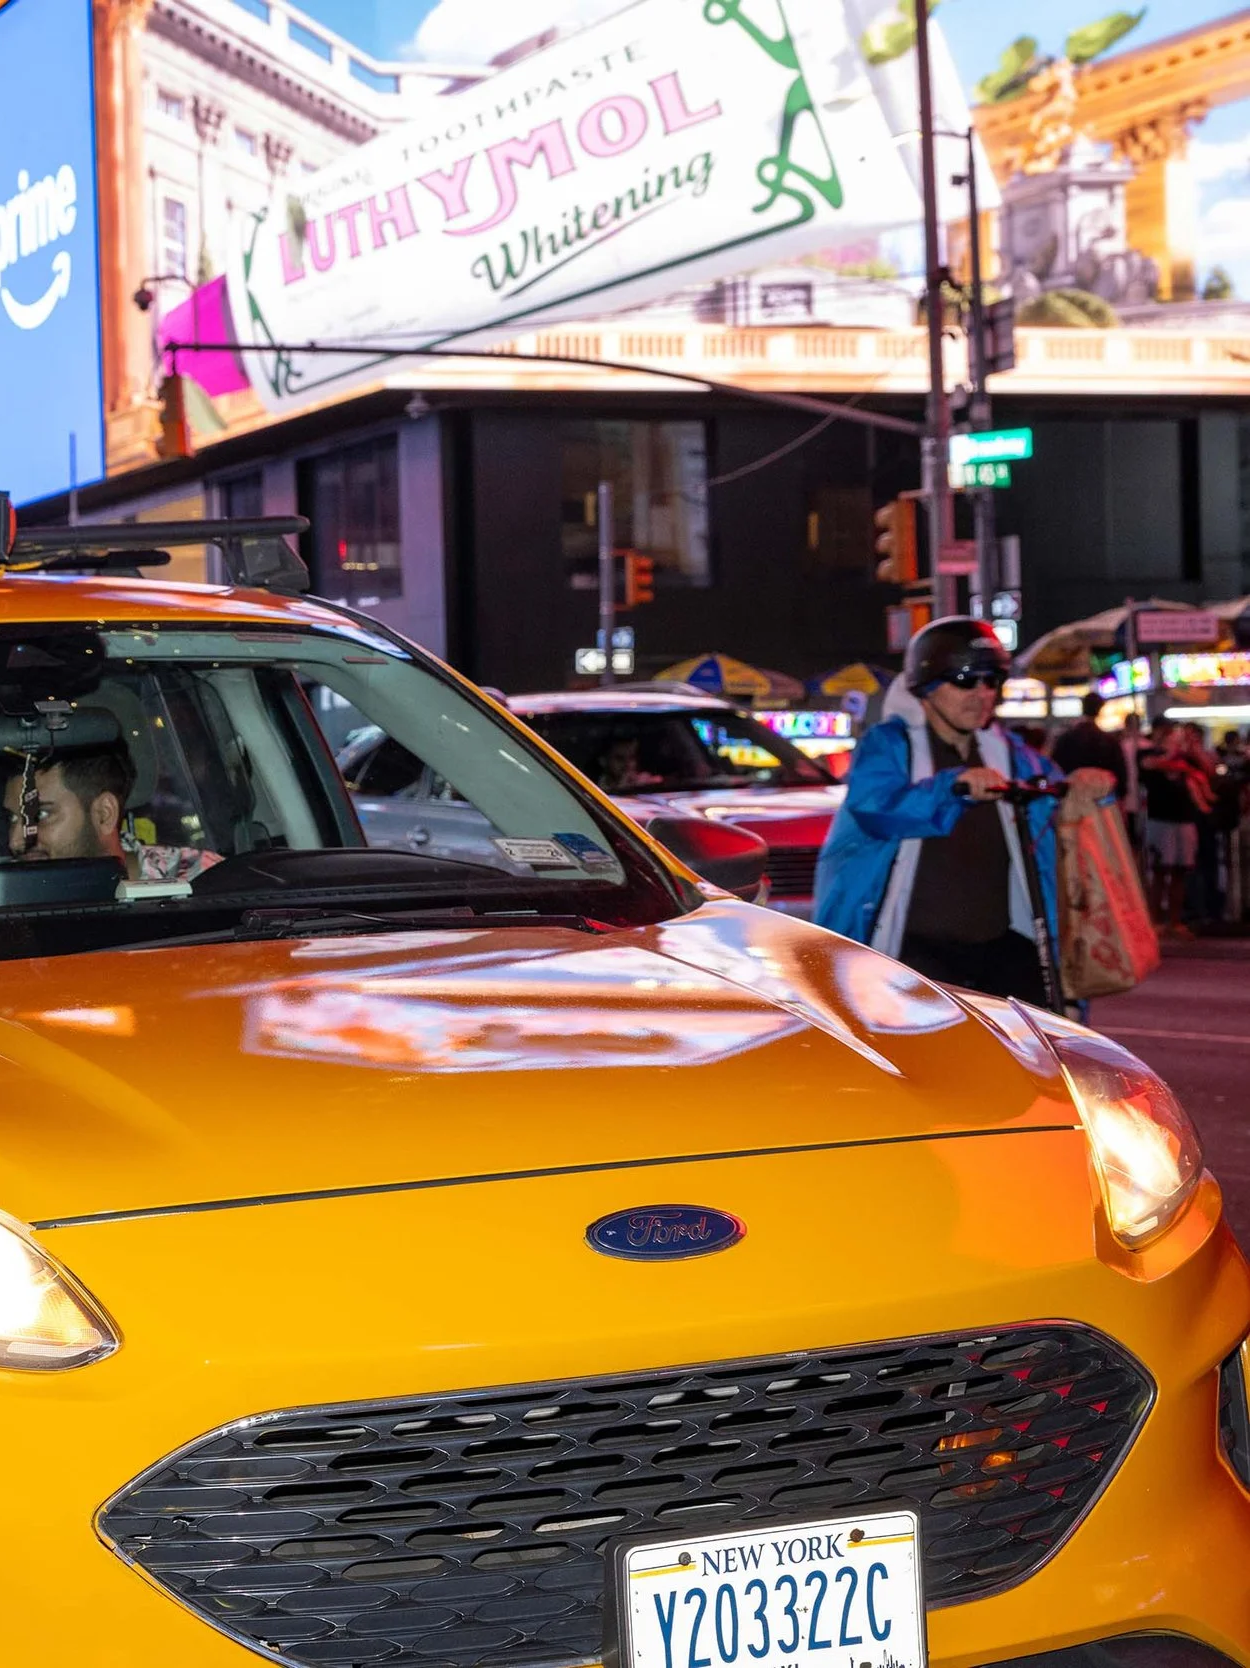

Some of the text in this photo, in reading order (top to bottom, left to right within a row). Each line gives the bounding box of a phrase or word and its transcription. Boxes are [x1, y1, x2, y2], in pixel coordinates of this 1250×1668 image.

[401, 36, 648, 162] TOOTHPASTE
[278, 69, 723, 287] LUTHYMOL
[470, 151, 716, 292] Whitening
[626, 1212, 712, 1247] Ford
[700, 1532, 845, 1577] NEW YORK
[652, 1560, 893, 1668] Y203322C
